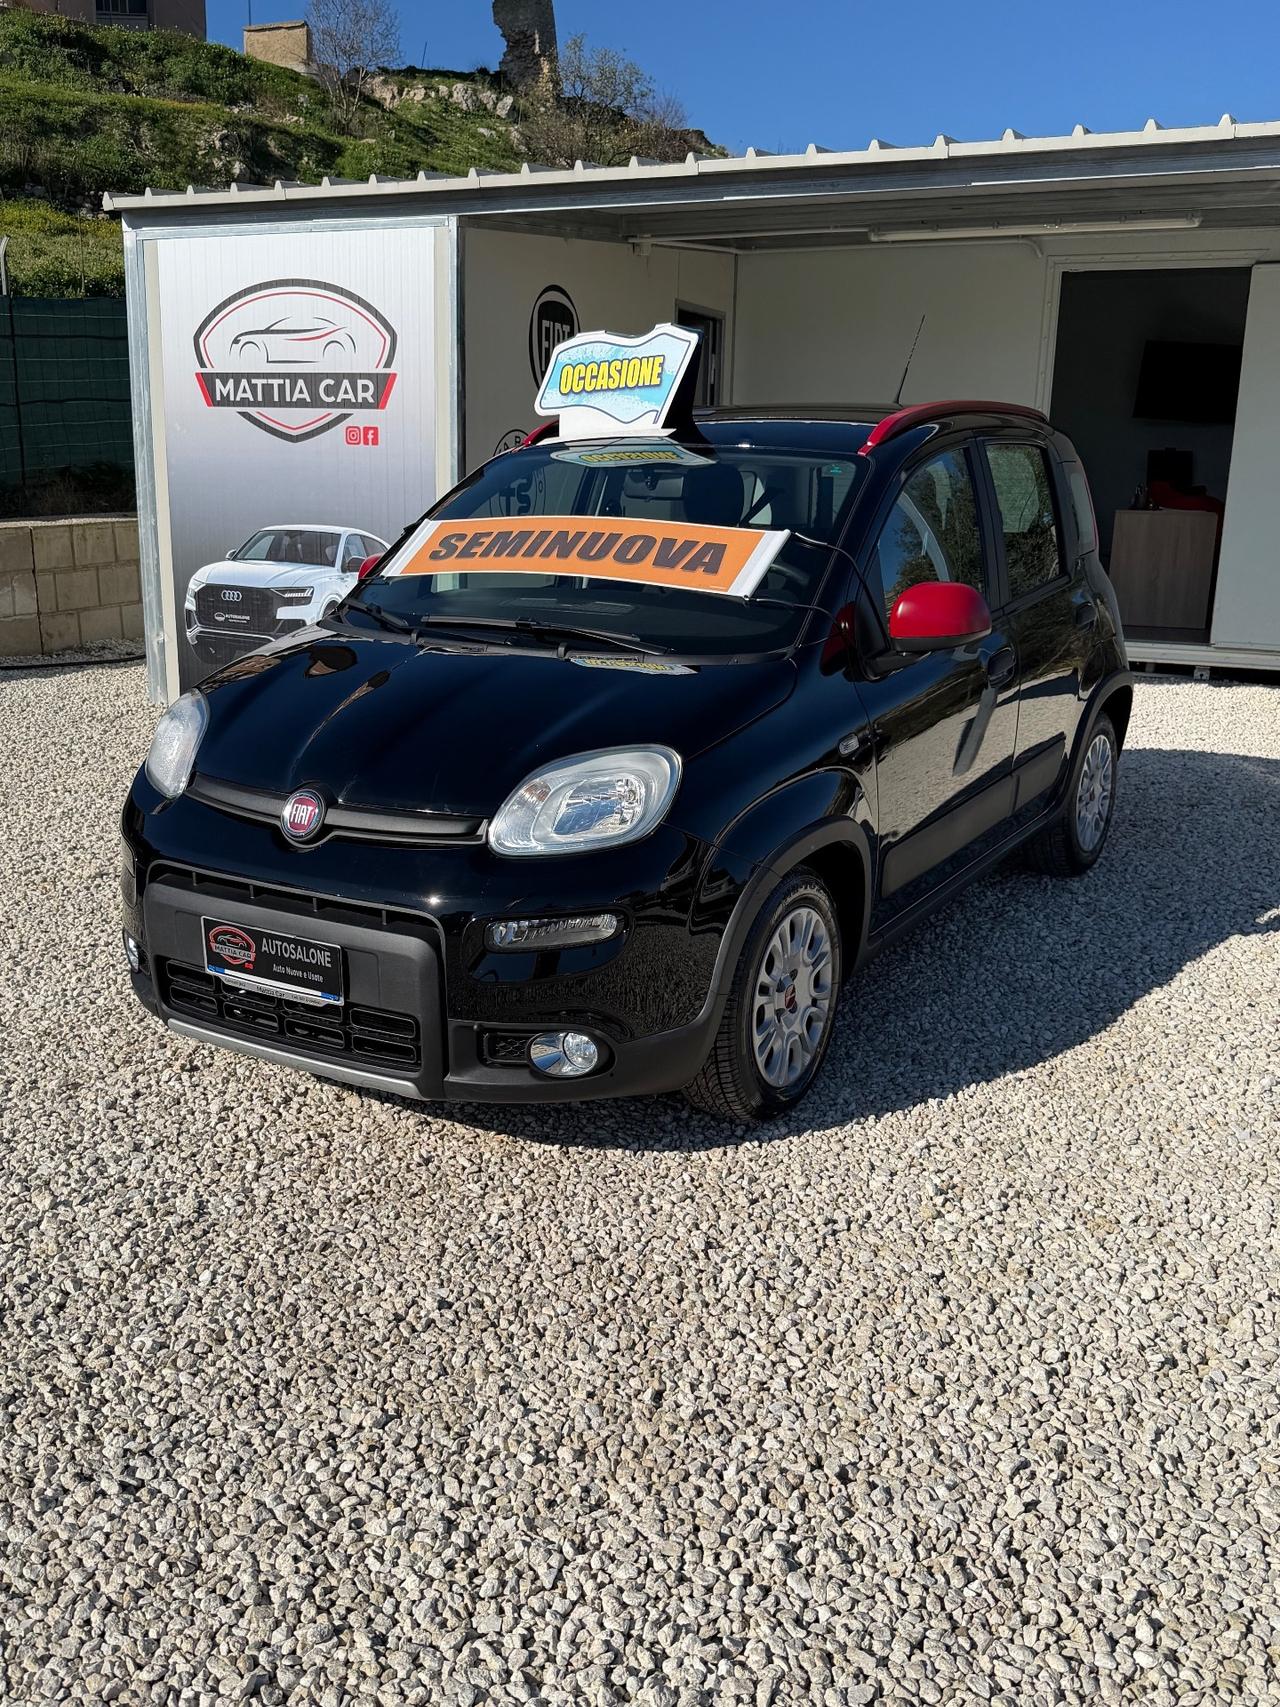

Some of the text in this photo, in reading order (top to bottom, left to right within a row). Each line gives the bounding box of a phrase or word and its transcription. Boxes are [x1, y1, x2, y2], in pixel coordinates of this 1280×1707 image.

[558, 354, 666, 397] OCCASIONE
[215, 378, 376, 403] MATTIA CAR
[428, 529, 729, 575] SEMINUOVA
[290, 803, 314, 826] FIAT
[261, 937, 332, 968] AUTOSALONE
[272, 963, 286, 974] Auto
